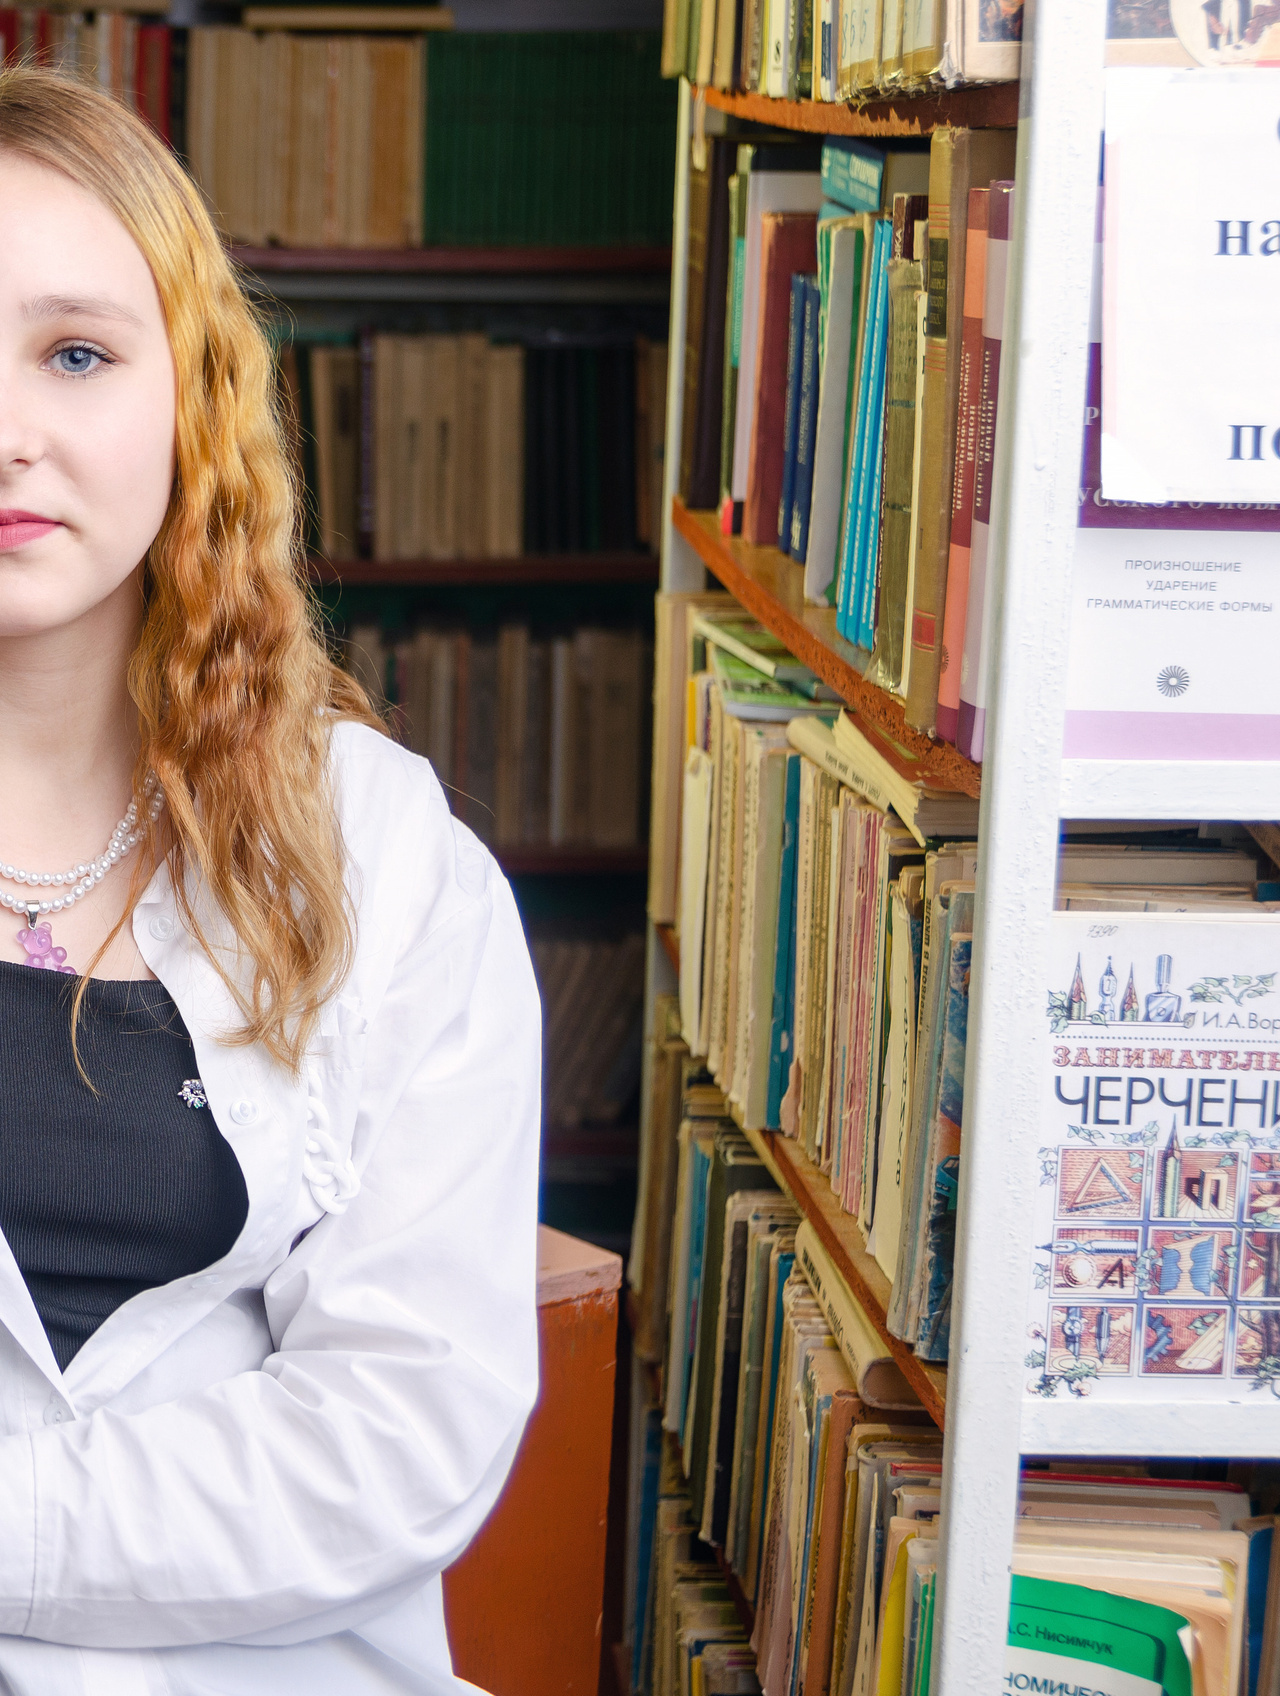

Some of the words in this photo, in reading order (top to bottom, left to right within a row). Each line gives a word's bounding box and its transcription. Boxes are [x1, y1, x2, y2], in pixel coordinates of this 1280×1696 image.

[1226, 424, 1280, 461] п
[1124, 559, 1242, 573] ПРОИЗНОШЕНИЕ
[1146, 580, 1218, 593] УДАРЕНИЕ
[1086, 598, 1215, 612] ГРАММАТИЧЕСКИЕ
[1219, 600, 1273, 613] ФОРМЫ
[1035, 1626, 1114, 1656] Нисимчук
